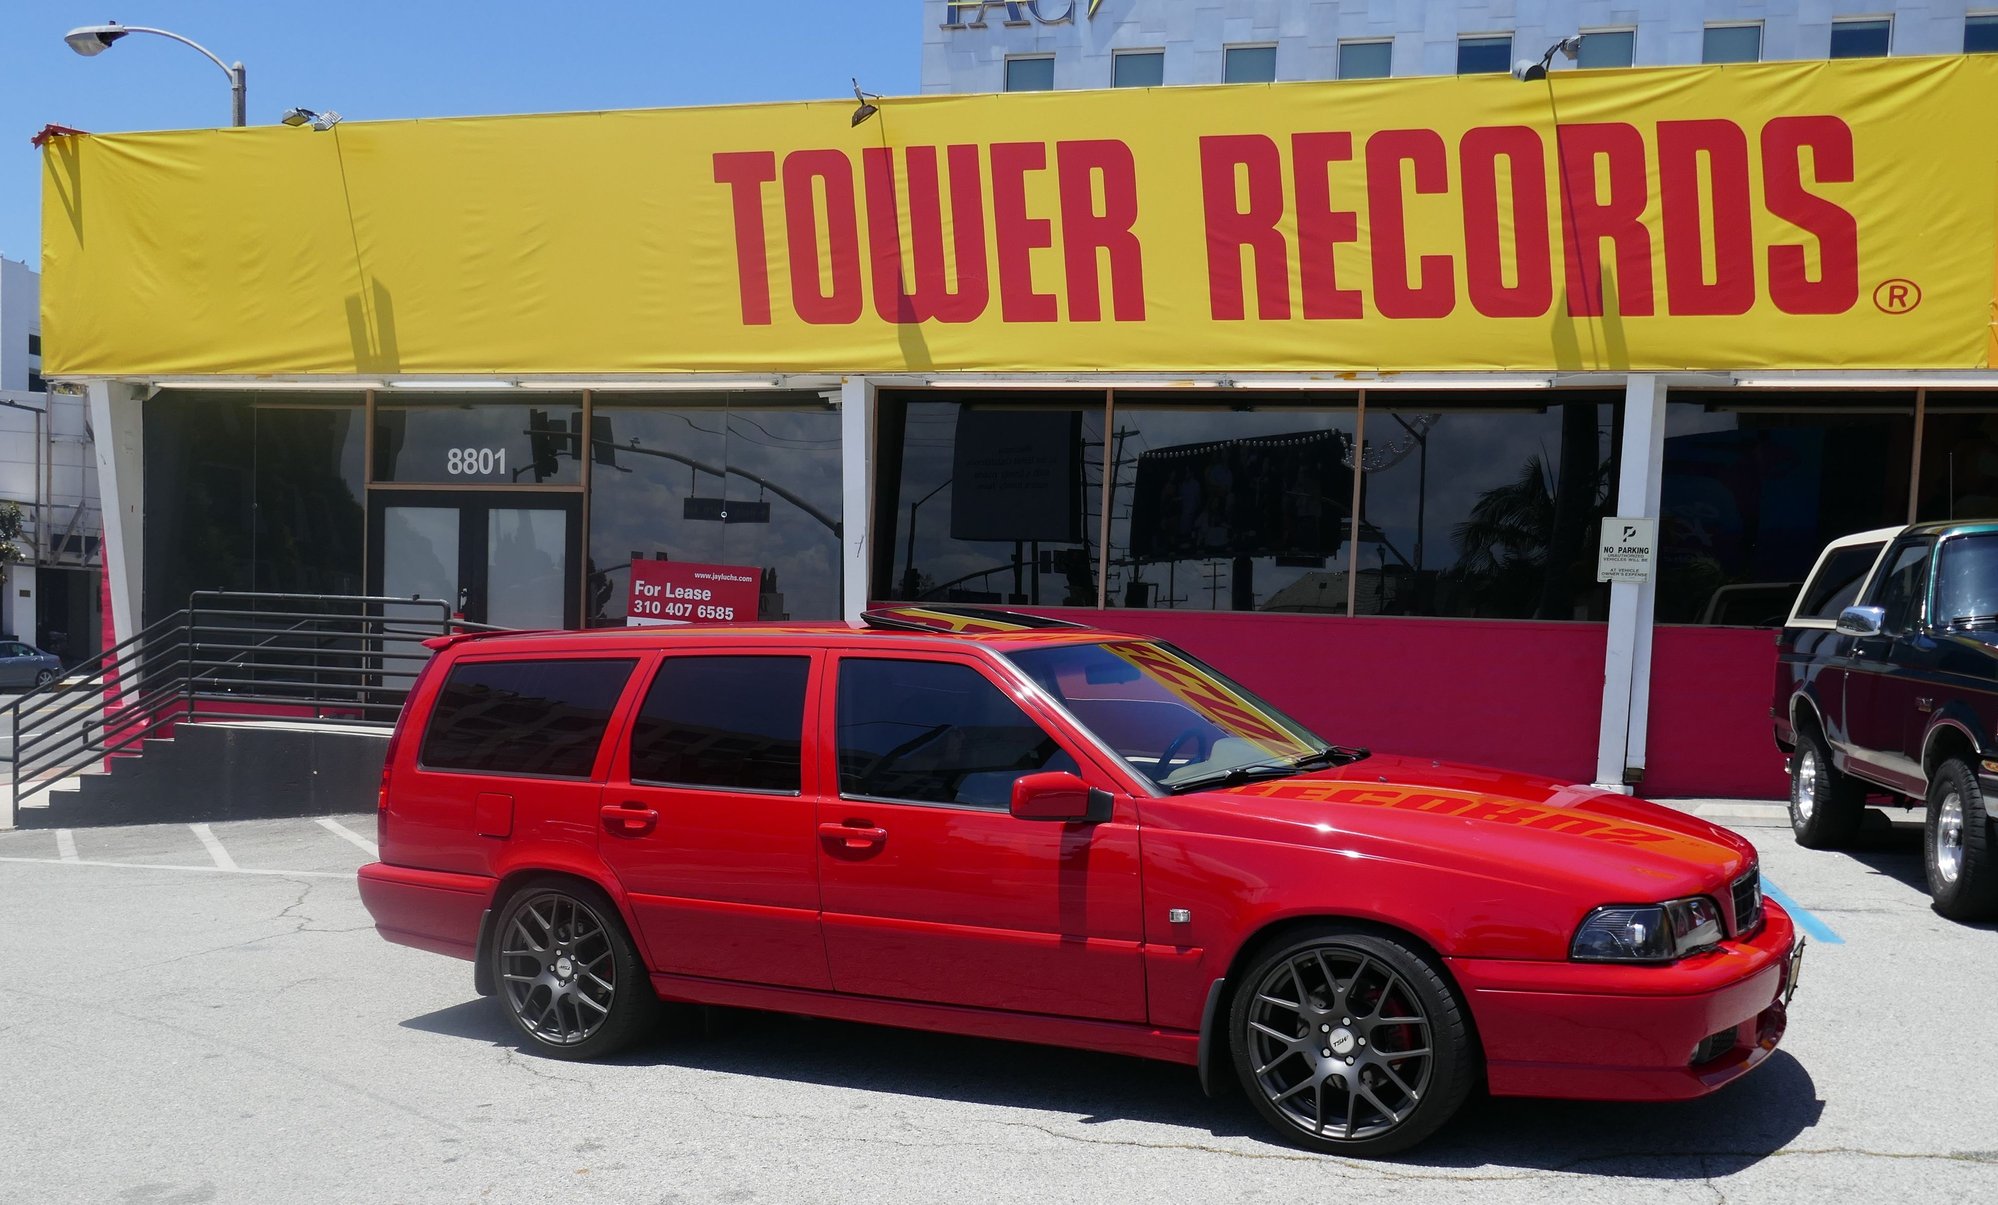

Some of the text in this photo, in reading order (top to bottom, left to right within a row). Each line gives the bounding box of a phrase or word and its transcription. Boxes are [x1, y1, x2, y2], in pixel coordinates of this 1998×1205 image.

[713, 139, 1146, 326] TOWER
[1199, 115, 1859, 320] RECORDS
[447, 447, 506, 475] 8801
[1618, 546, 1649, 554] PARKING
[694, 572, 753, 582] www.jayluchs.com
[634, 580, 712, 601] For Lease
[634, 600, 734, 621] 310 407 6585
